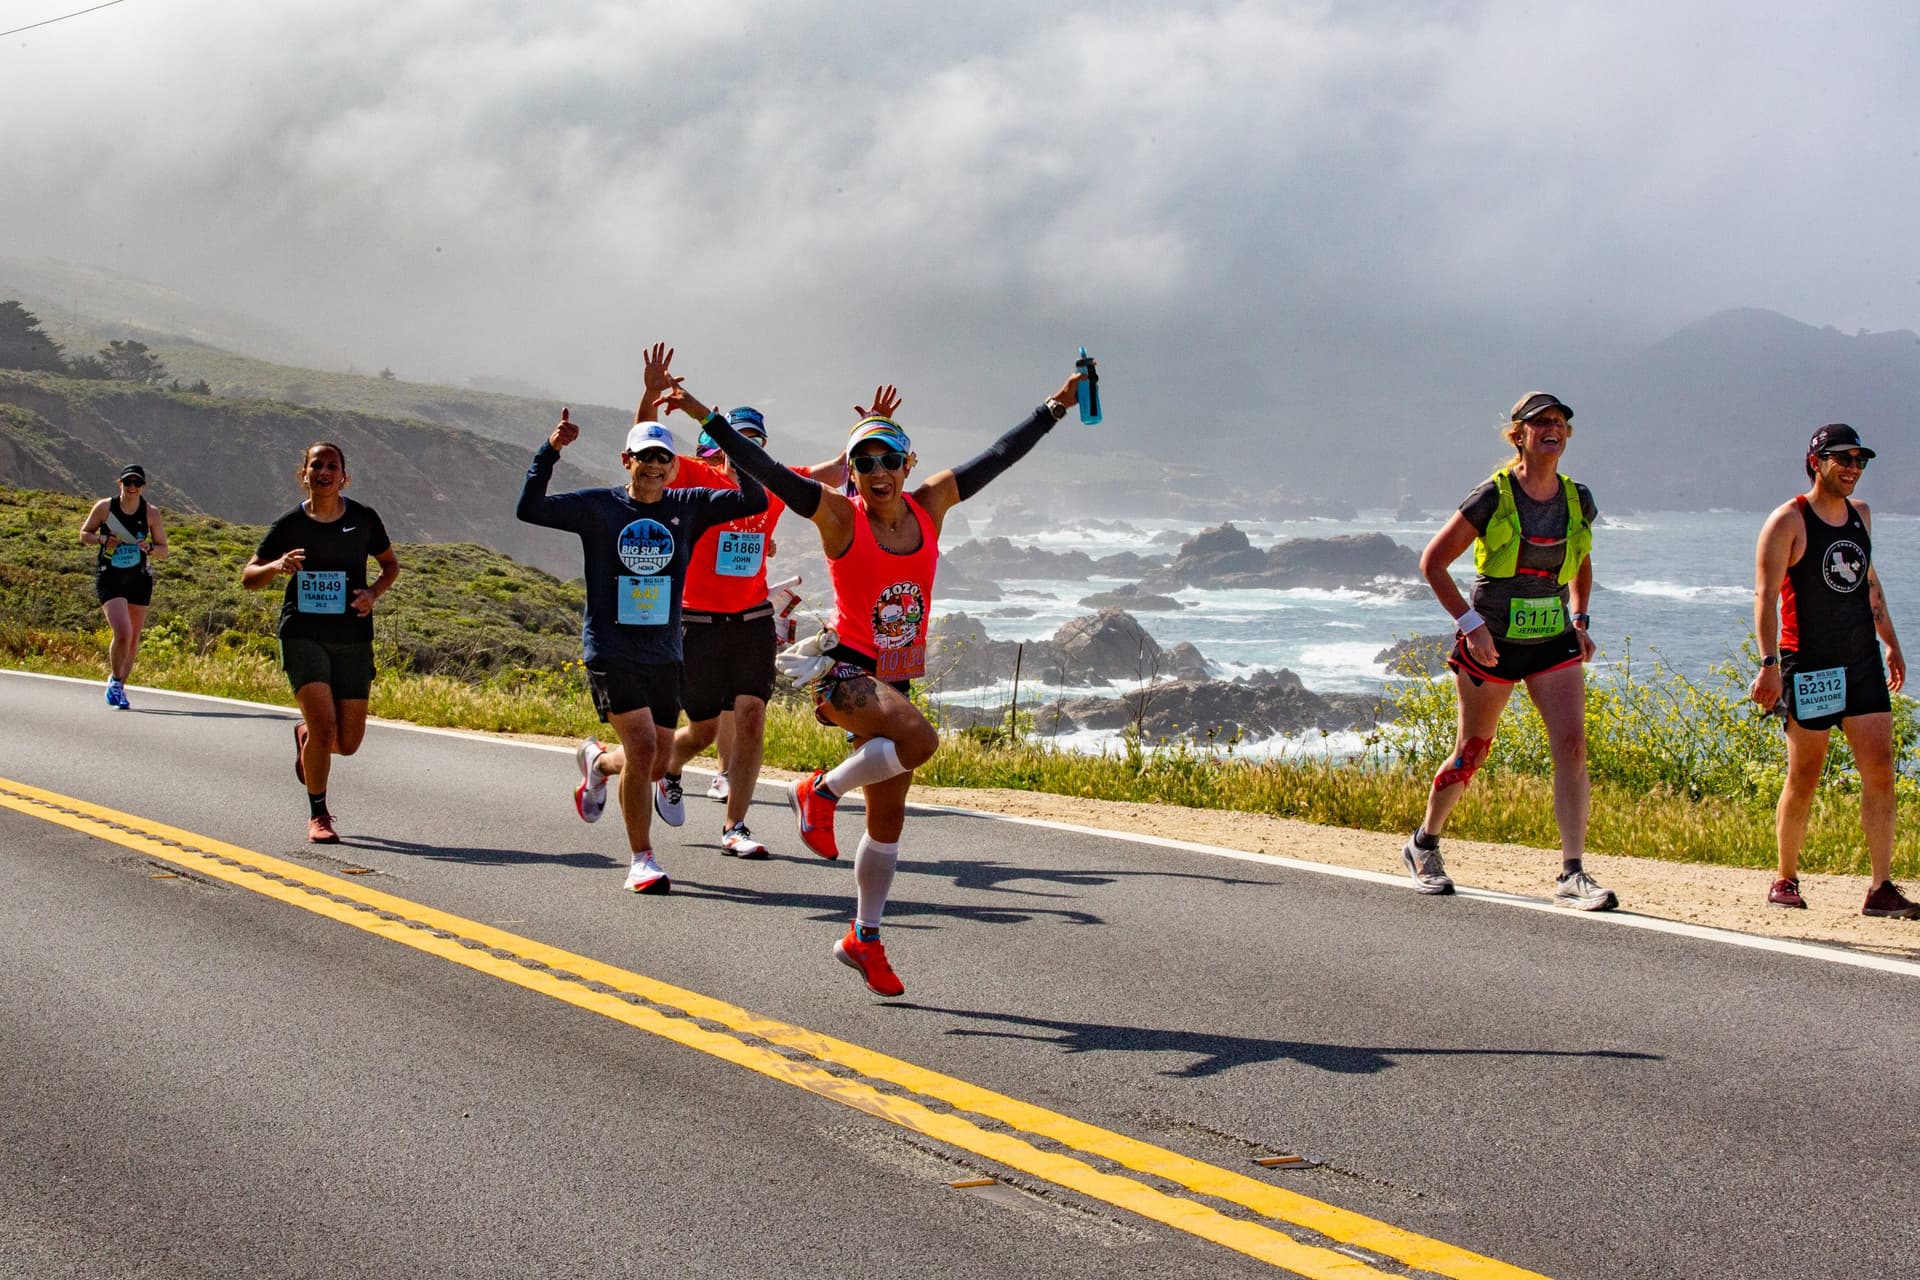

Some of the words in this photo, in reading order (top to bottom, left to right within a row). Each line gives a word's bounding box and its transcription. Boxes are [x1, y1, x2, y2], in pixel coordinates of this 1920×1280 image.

[621, 545, 639, 554] BIG
[641, 546, 660, 555] SUR
[660, 537, 673, 555] 2
[723, 541, 760, 554] B1869
[302, 580, 341, 592] B1849
[882, 582, 919, 600] 2020
[304, 593, 338, 601] ISABELLA
[1515, 609, 1560, 627] 6117
[1799, 679, 1841, 696] B2312
[1800, 692, 1842, 706] SALVATORE
